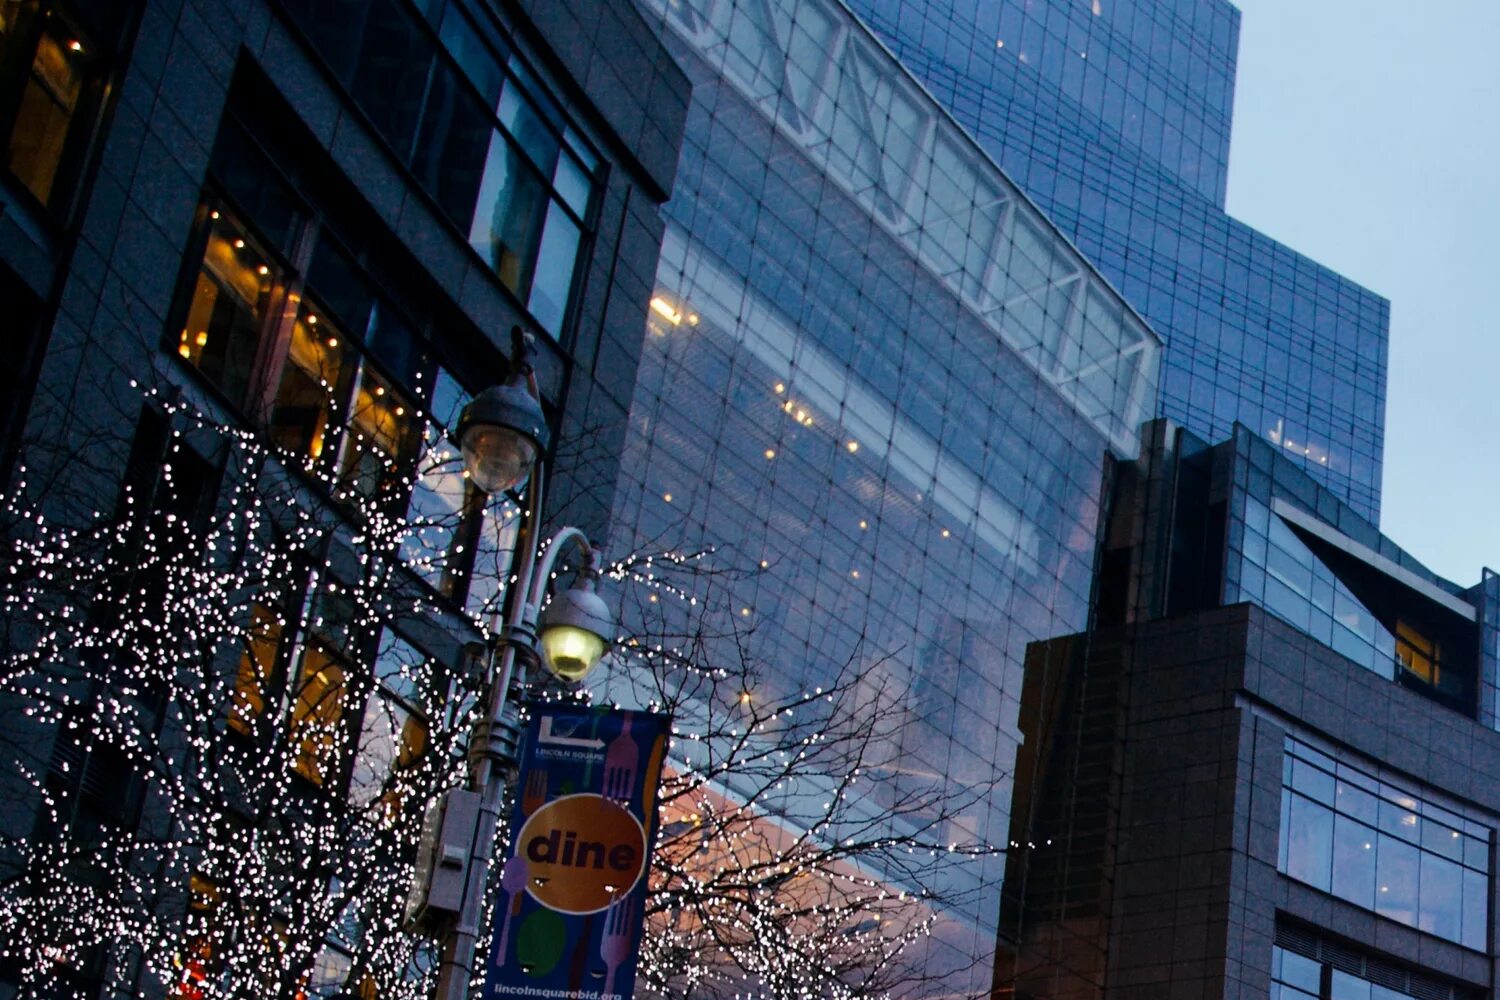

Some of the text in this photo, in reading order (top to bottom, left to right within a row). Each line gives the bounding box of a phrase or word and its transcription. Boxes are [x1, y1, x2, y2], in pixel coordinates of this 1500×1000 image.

[536, 748, 605, 760] LINCOLN SQUARE
[527, 829, 637, 871] dine
